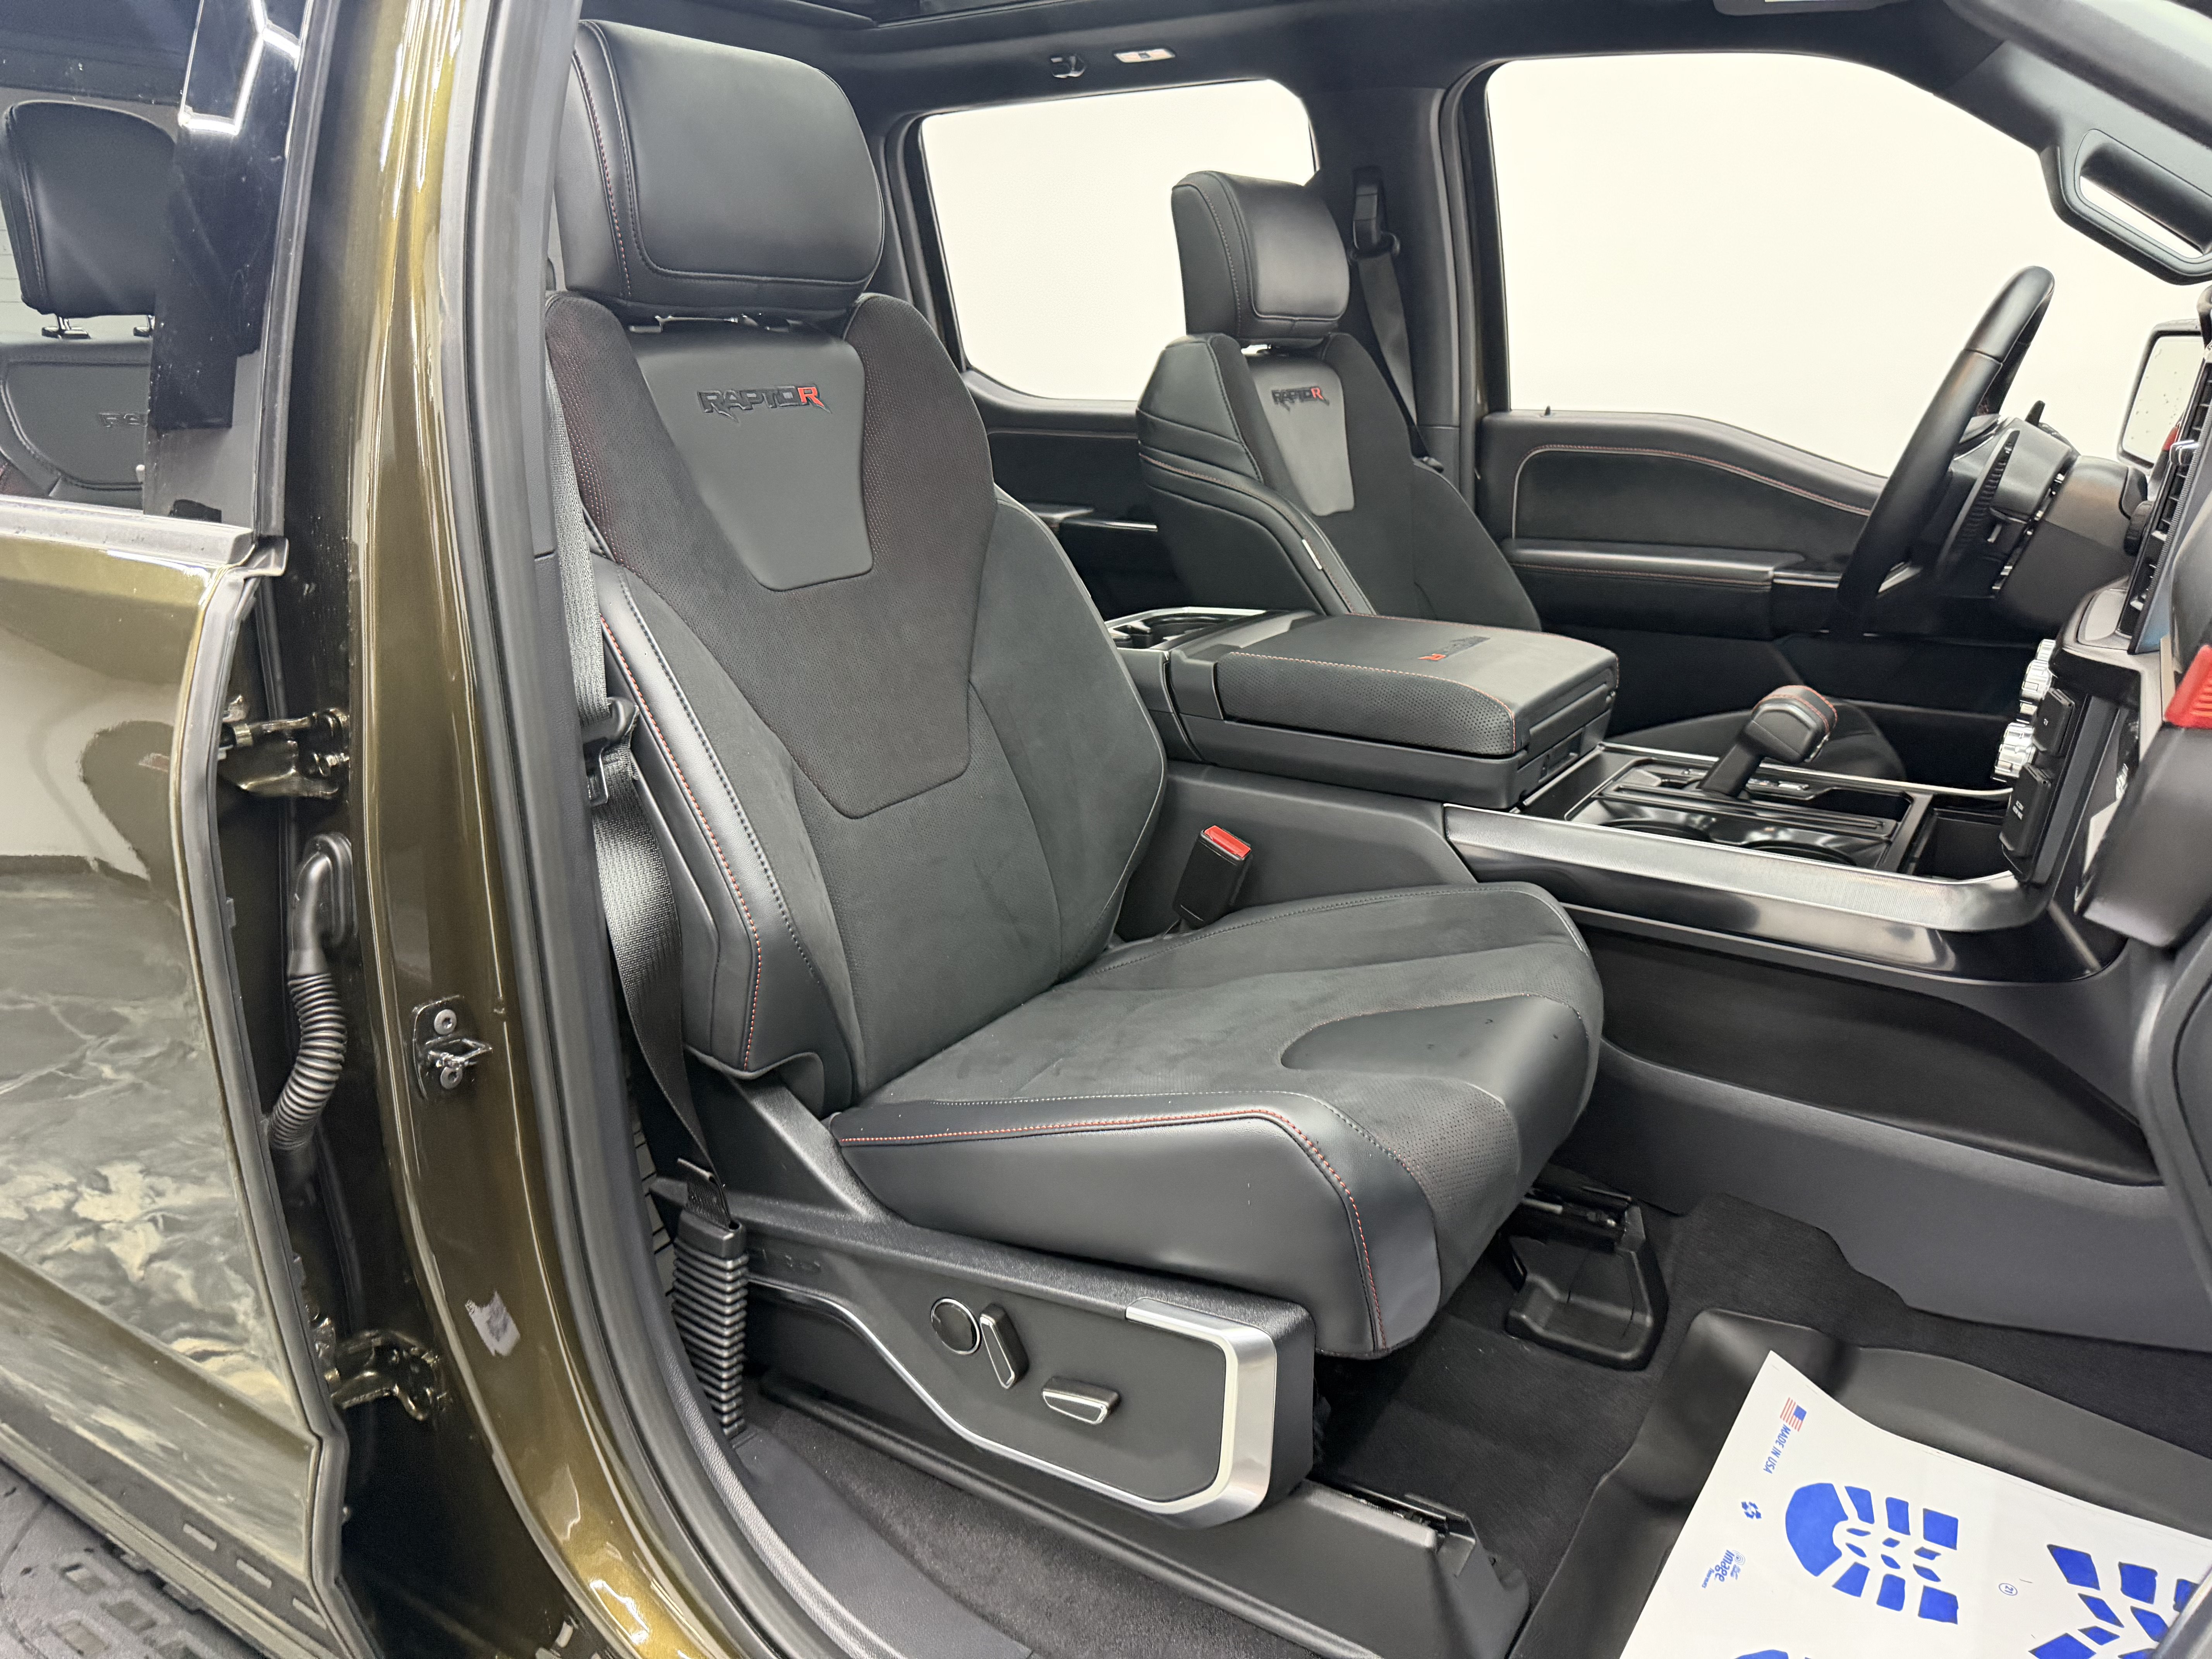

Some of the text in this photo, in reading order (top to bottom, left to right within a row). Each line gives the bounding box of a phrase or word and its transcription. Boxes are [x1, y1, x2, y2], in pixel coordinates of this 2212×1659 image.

[697, 385, 832, 423] RAPTOR
[1271, 386, 1329, 413] RAPTOR
[1763, 1423, 1791, 1474] MADE IN USA
